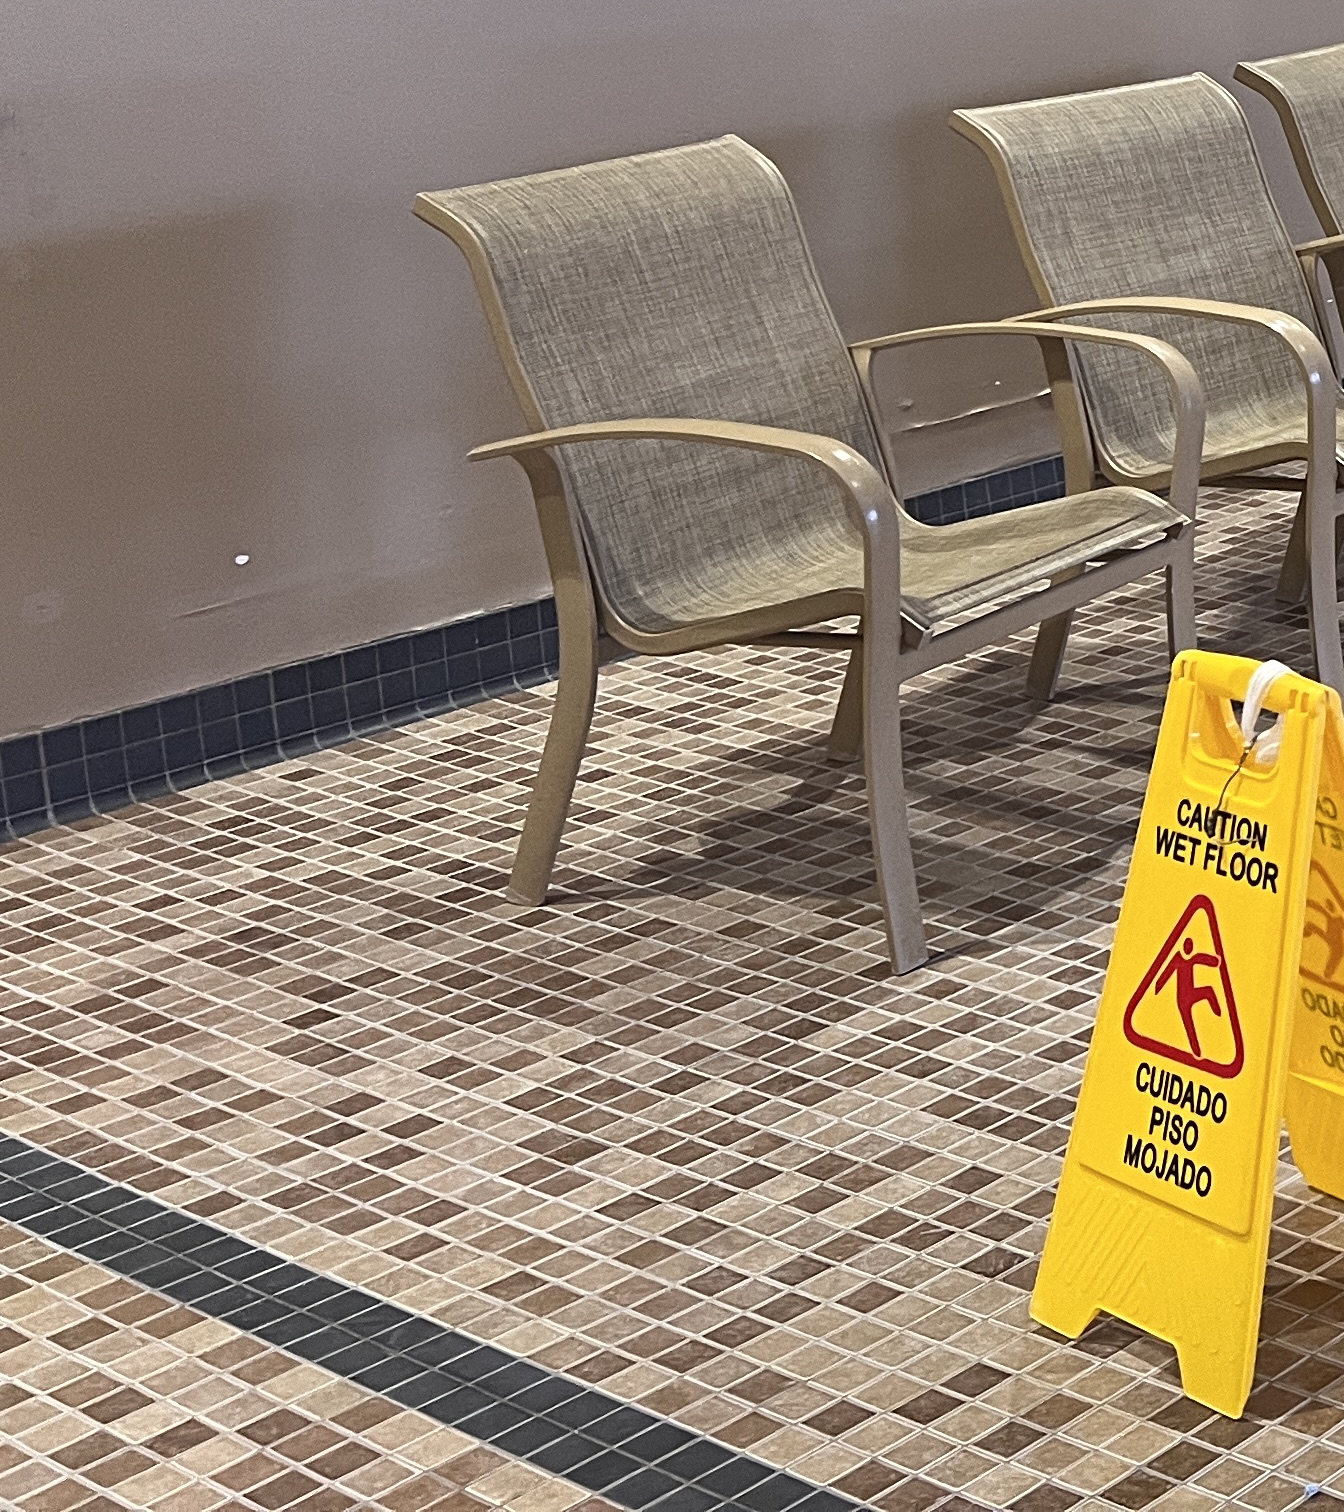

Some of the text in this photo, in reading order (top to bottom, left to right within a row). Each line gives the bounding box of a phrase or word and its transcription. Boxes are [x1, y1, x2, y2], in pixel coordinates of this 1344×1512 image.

[1177, 798, 1268, 852] CAUTION
[1156, 825, 1279, 894] WET FLOOR
[1135, 1062, 1227, 1124] CUIDADO
[1148, 1105, 1199, 1152] PISO
[1123, 1134, 1212, 1197] MOJADO
